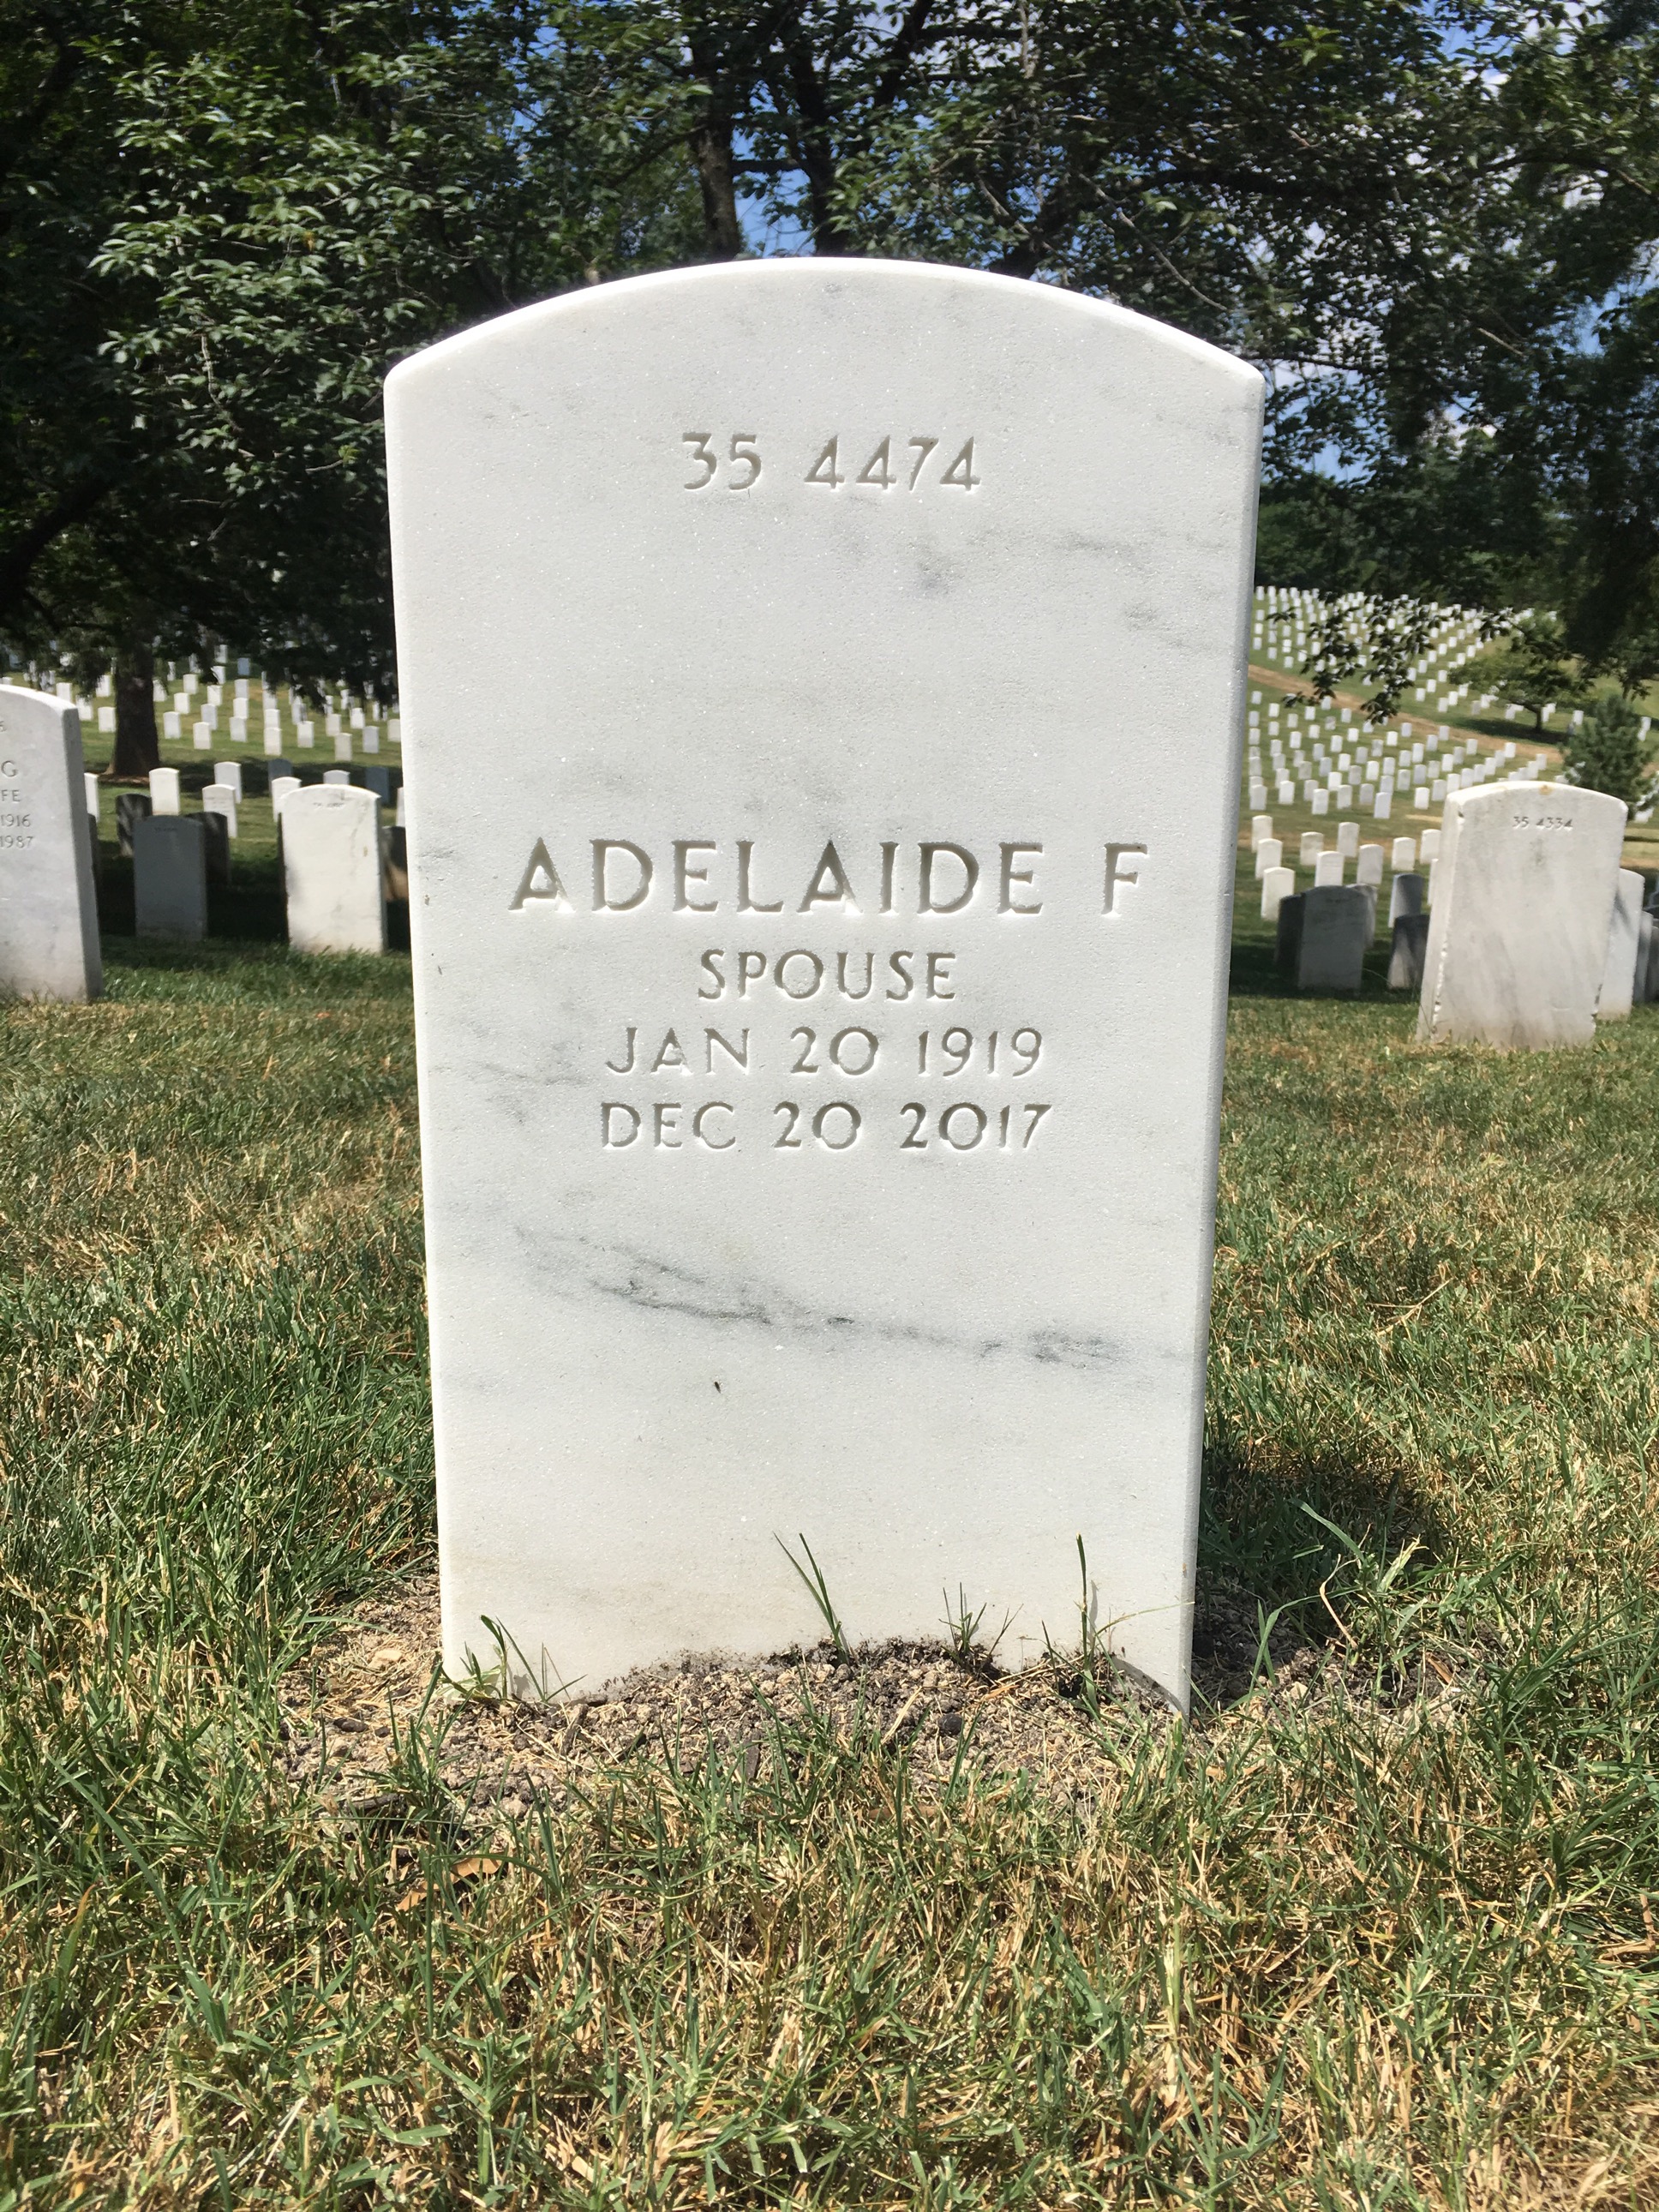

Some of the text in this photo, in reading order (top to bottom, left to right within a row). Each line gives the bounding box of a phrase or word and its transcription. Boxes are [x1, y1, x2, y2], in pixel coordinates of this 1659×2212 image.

[682, 432, 982, 491] 35 4474
[1, 760, 18, 777] G
[0, 813, 31, 827] 1916
[0, 835, 33, 848] 1987
[1512, 816, 1574, 830] 35 4334
[507, 836, 1148, 916] ADELAIDE F
[698, 949, 956, 1000] SPOUSE
[605, 1026, 1043, 1077] JAN 20 1919
[601, 1100, 1052, 1150] DEC 20 2017
